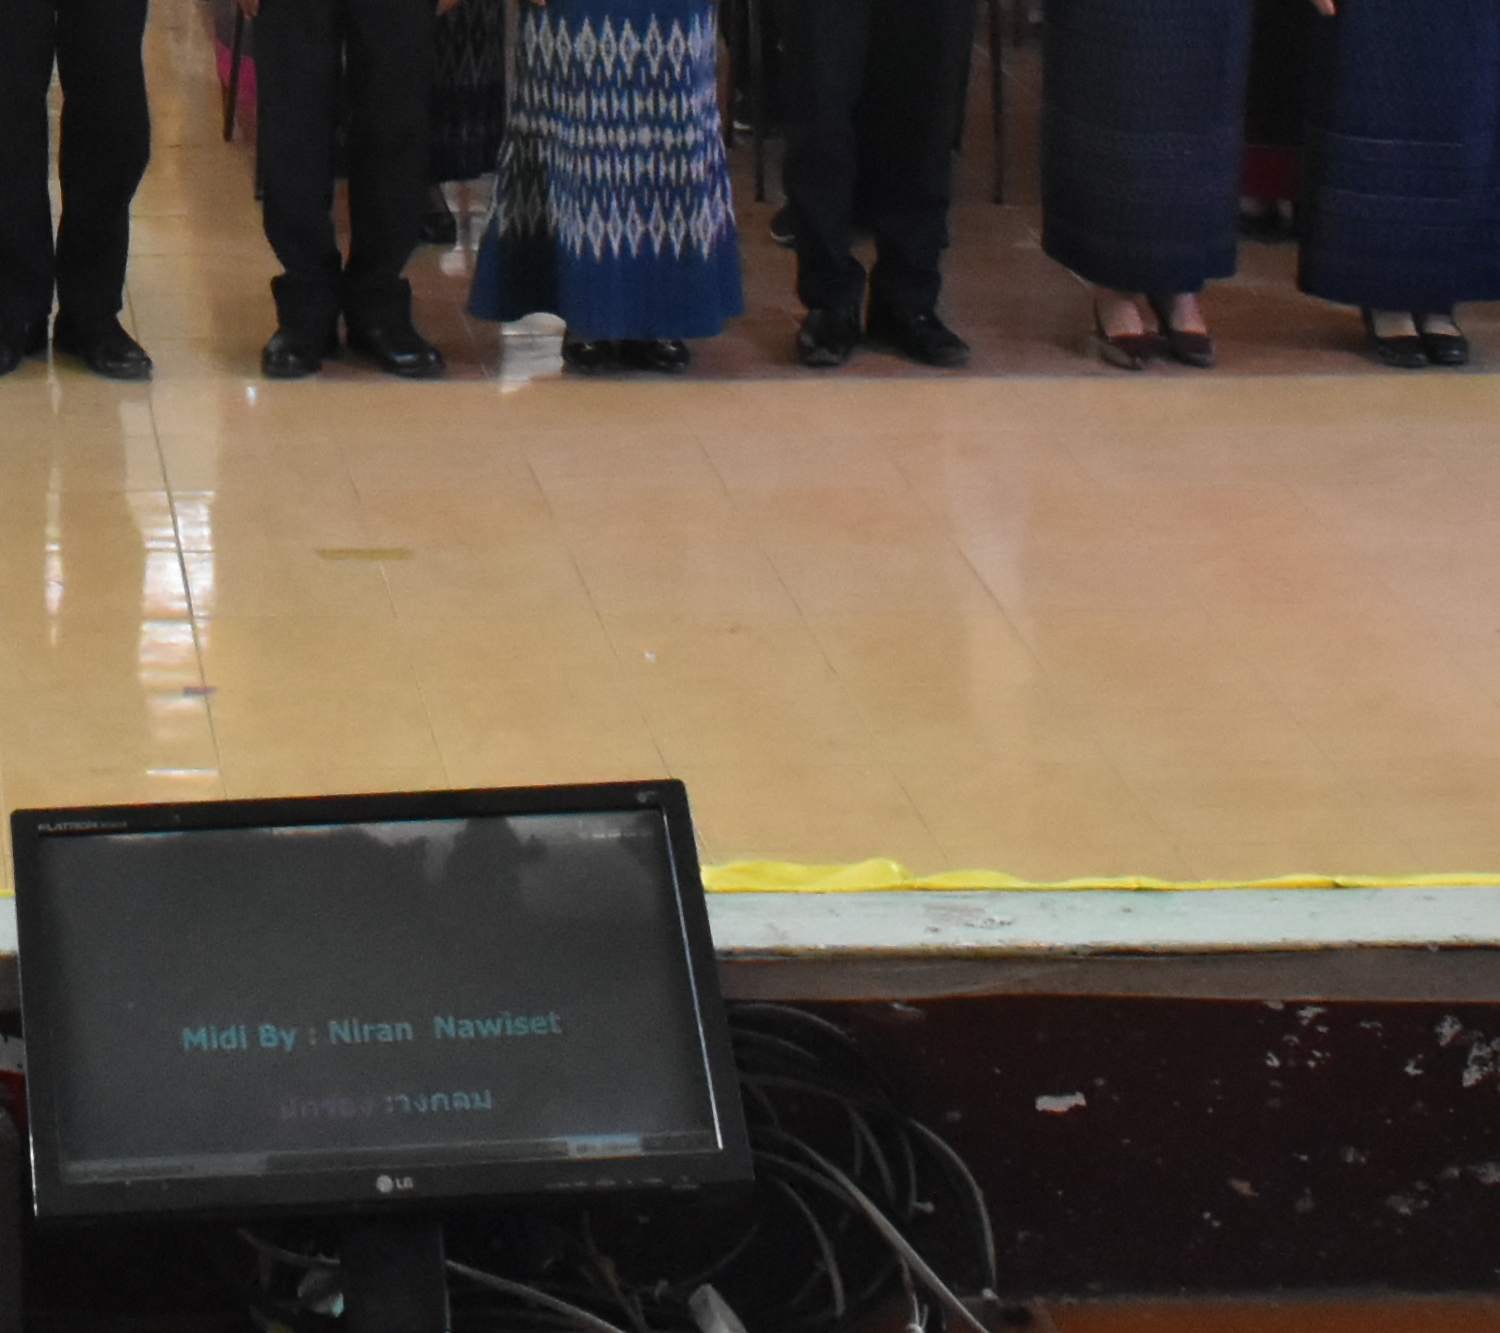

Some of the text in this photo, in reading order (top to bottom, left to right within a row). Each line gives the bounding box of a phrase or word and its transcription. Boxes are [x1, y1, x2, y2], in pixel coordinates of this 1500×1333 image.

[182, 1024, 248, 1051] Midi
[257, 1023, 298, 1052] By
[328, 1016, 414, 1045] Niran
[433, 1010, 563, 1040] Nawiset
